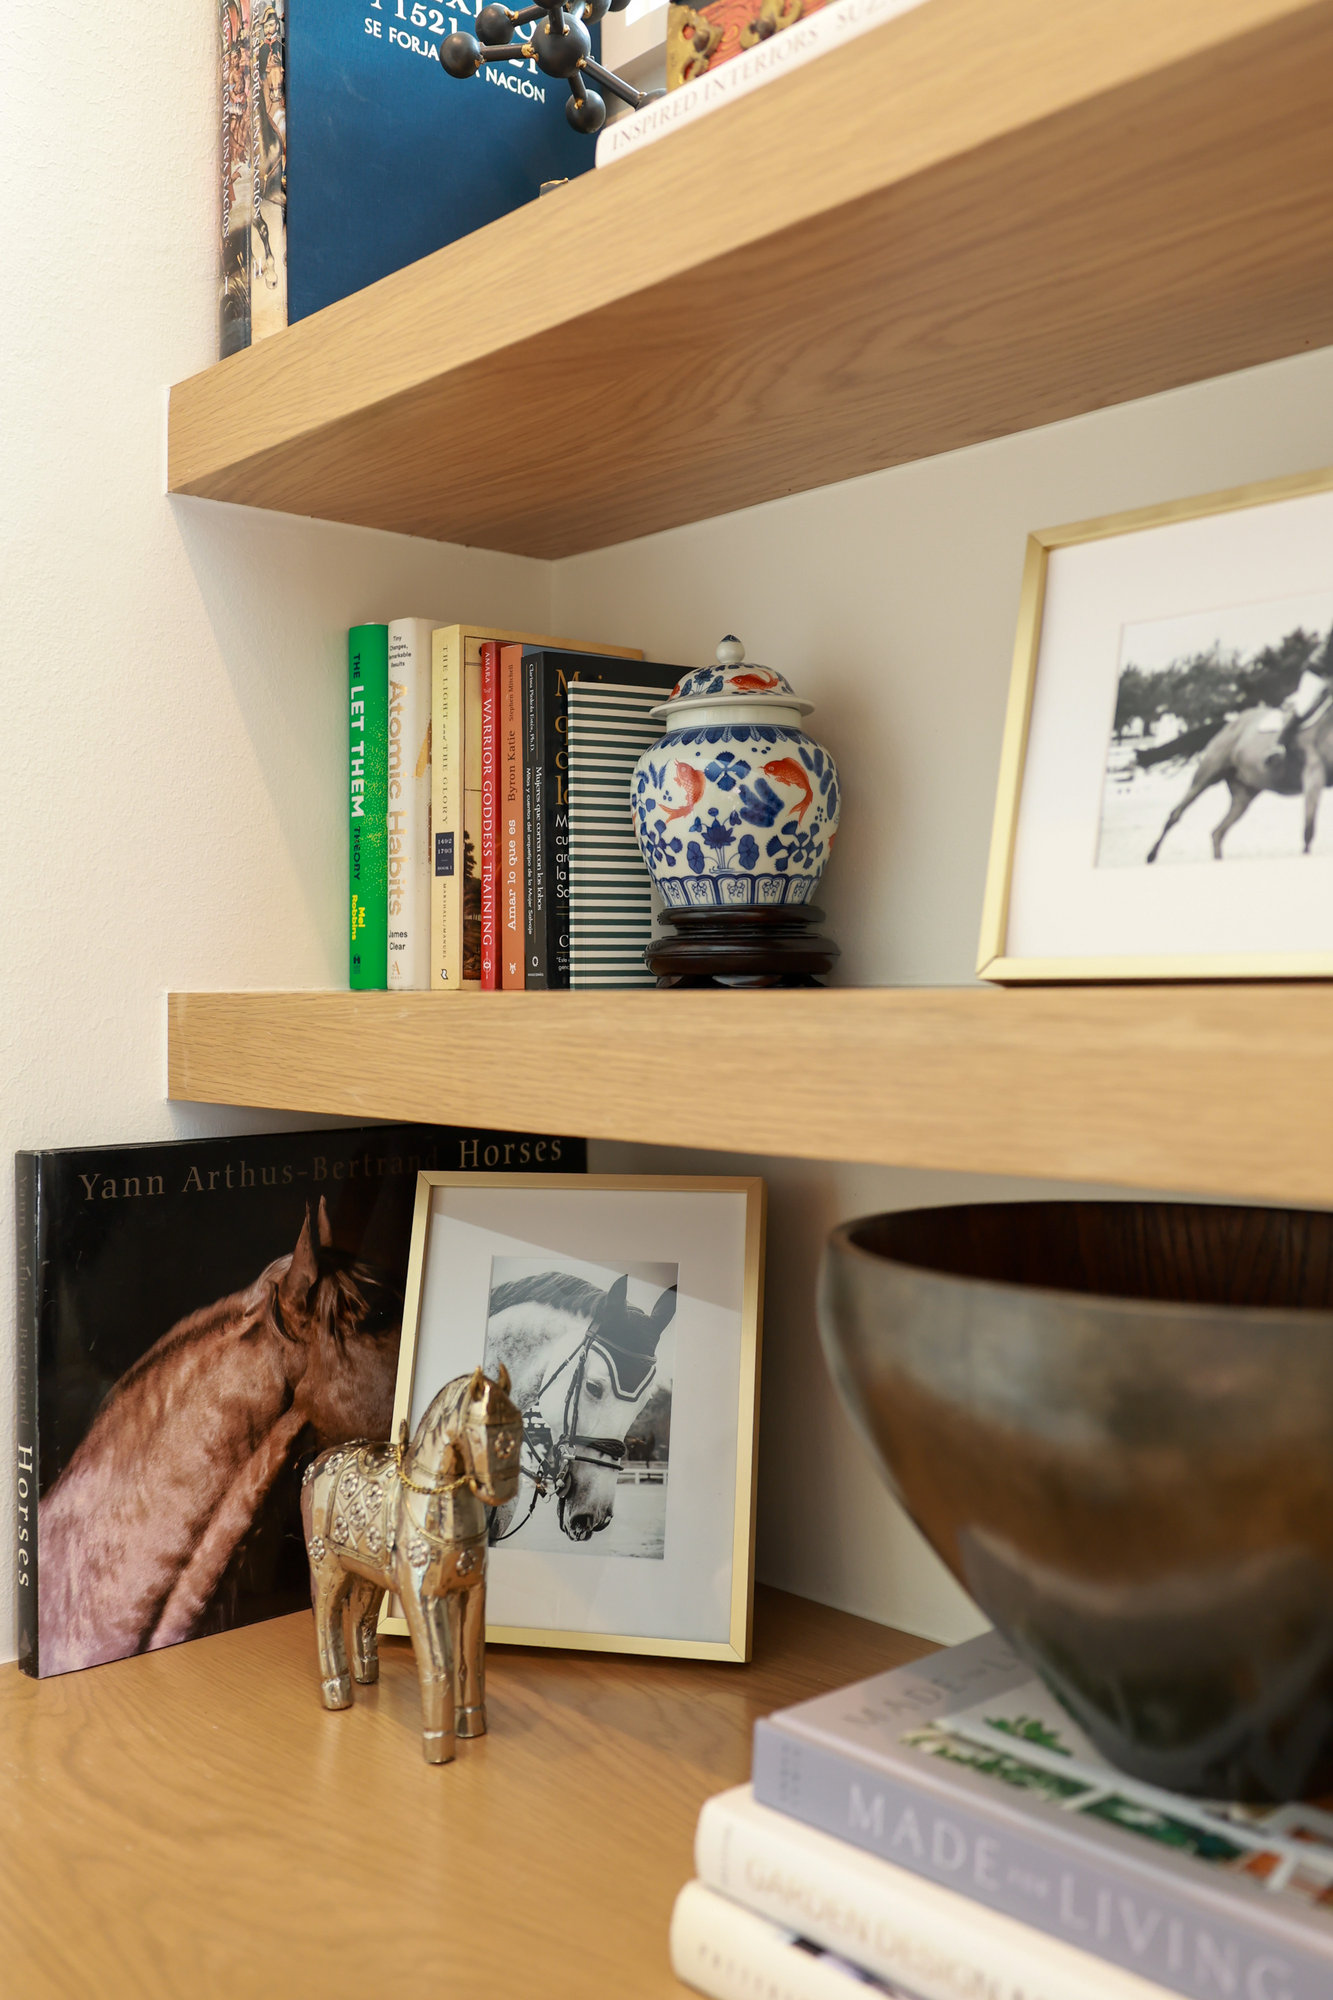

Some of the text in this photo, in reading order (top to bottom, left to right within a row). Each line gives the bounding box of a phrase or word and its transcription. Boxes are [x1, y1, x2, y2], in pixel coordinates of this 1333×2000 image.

[364, 17, 383, 39] SE
[388, 25, 440, 61] FORJA
[485, 65, 545, 104] NACIÓN
[222, 84, 230, 132] FORJA
[252, 61, 260, 110] FORJA
[612, 27, 819, 150] INSPIRED INTERIORS
[222, 136, 230, 172] UNA
[252, 115, 260, 151] UNA
[222, 180, 231, 238] NACIÓN
[252, 155, 262, 220] NACIÓN
[482, 698, 492, 776] WARRIOR
[507, 730, 516, 762] Katie
[350, 652, 364, 881] THE LET THEM THEORY
[507, 764, 518, 802] Byron
[534, 766, 542, 802] Mujeres
[388, 680, 409, 917] Atomic Habits
[482, 780, 492, 857] GODDESS
[508, 819, 516, 835] es
[508, 840, 518, 866] que
[527, 868, 532, 878] de
[556, 866, 567, 881] la
[507, 871, 516, 884] lo
[527, 878, 532, 886] la
[358, 906, 366, 928] Mel
[482, 862, 492, 946] TRAINING
[507, 888, 516, 931] Amar
[78, 1138, 562, 1201] Yann Arthus-Bertrand Horses
[18, 1444, 33, 1587] Horses
[846, 1782, 1001, 1893] MADE
[1057, 1871, 1300, 2000] LIVING
